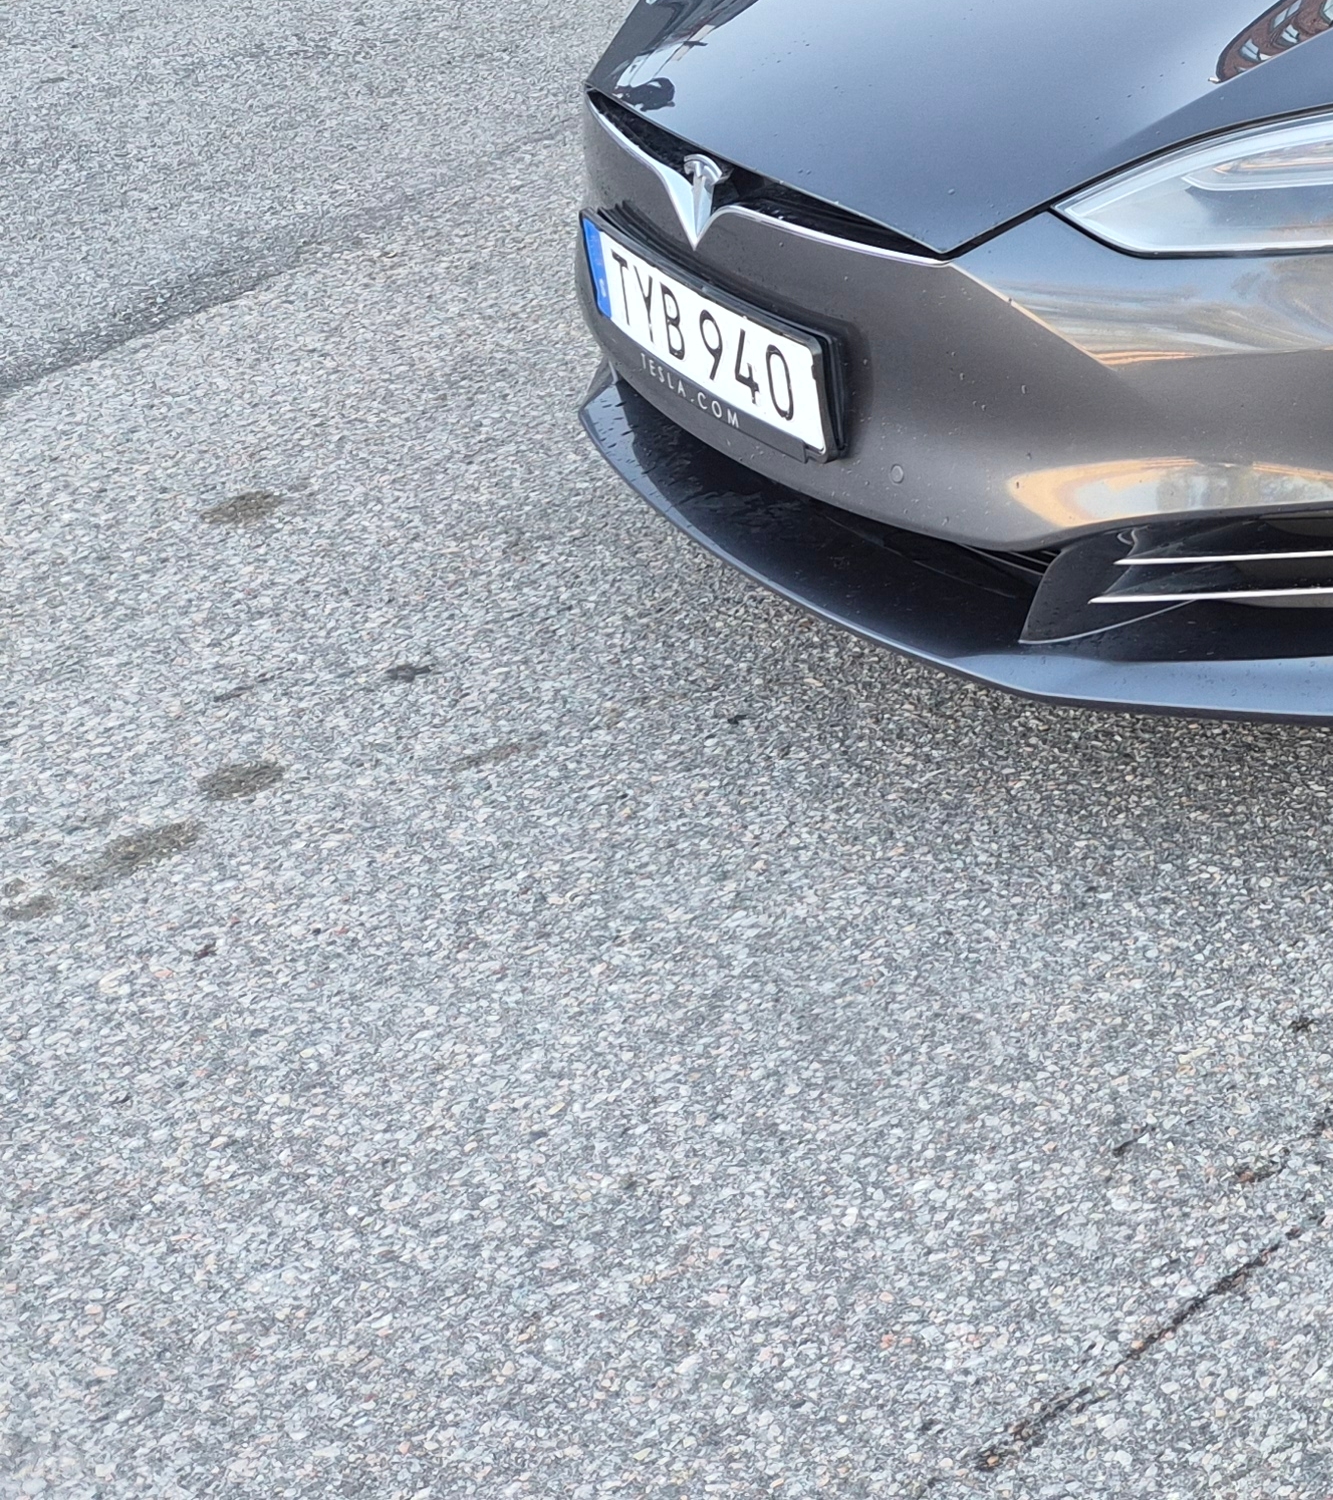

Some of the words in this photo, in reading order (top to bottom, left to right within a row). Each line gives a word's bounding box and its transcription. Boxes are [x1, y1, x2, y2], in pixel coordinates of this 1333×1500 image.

[610, 248, 686, 361] TYB
[699, 309, 795, 421] 940
[640, 352, 740, 429] TESLA.COM
